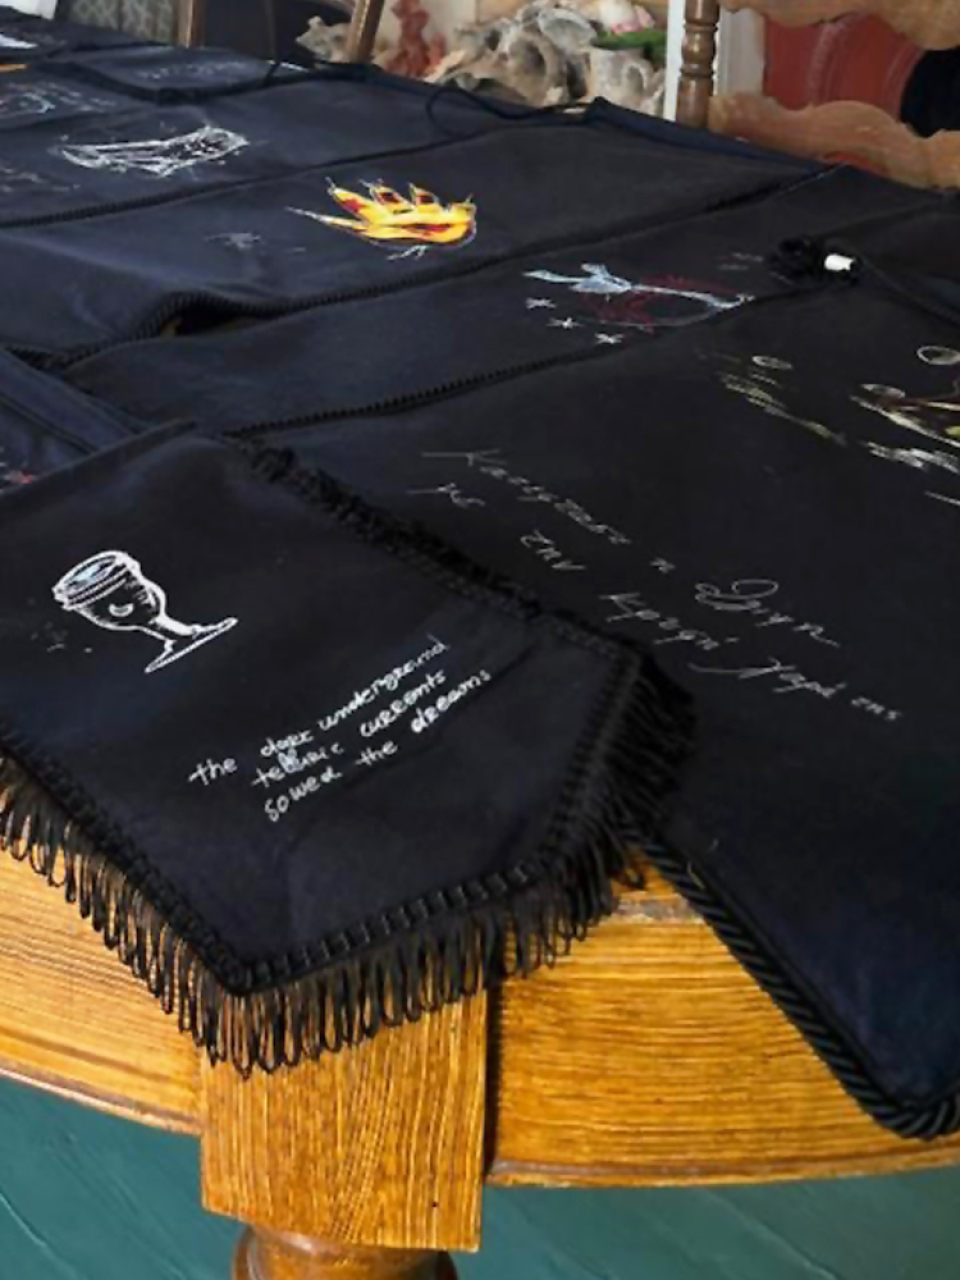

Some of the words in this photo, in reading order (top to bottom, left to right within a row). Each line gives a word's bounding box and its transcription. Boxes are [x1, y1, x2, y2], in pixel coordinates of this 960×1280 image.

[188, 758, 238, 787] the
[265, 765, 344, 823] sowed
[353, 740, 399, 767] the
